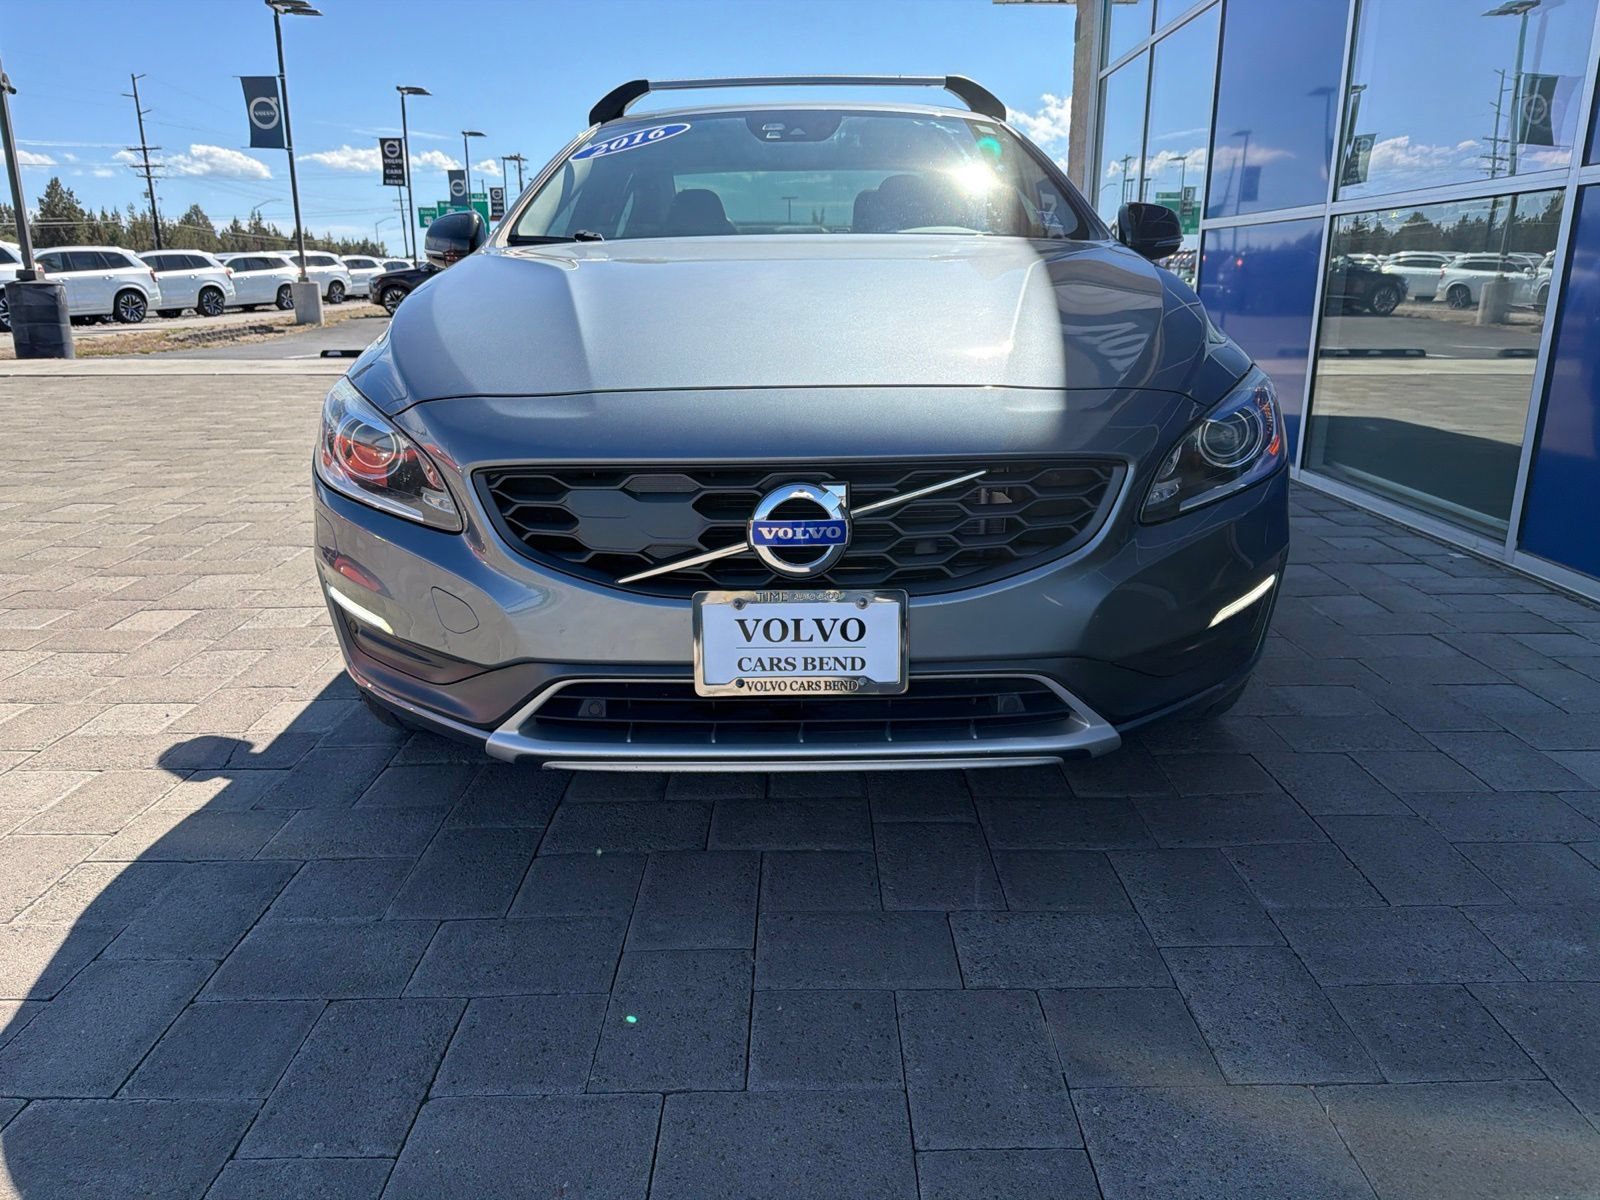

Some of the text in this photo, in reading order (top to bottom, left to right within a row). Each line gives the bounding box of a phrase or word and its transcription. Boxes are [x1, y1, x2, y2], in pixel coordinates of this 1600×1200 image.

[591, 128, 666, 156] 2016
[758, 526, 842, 540] VOLVO
[735, 618, 867, 643] VOLVO
[737, 656, 866, 672] CARS BEND
[746, 680, 858, 692] VOLVO CARS BEND
